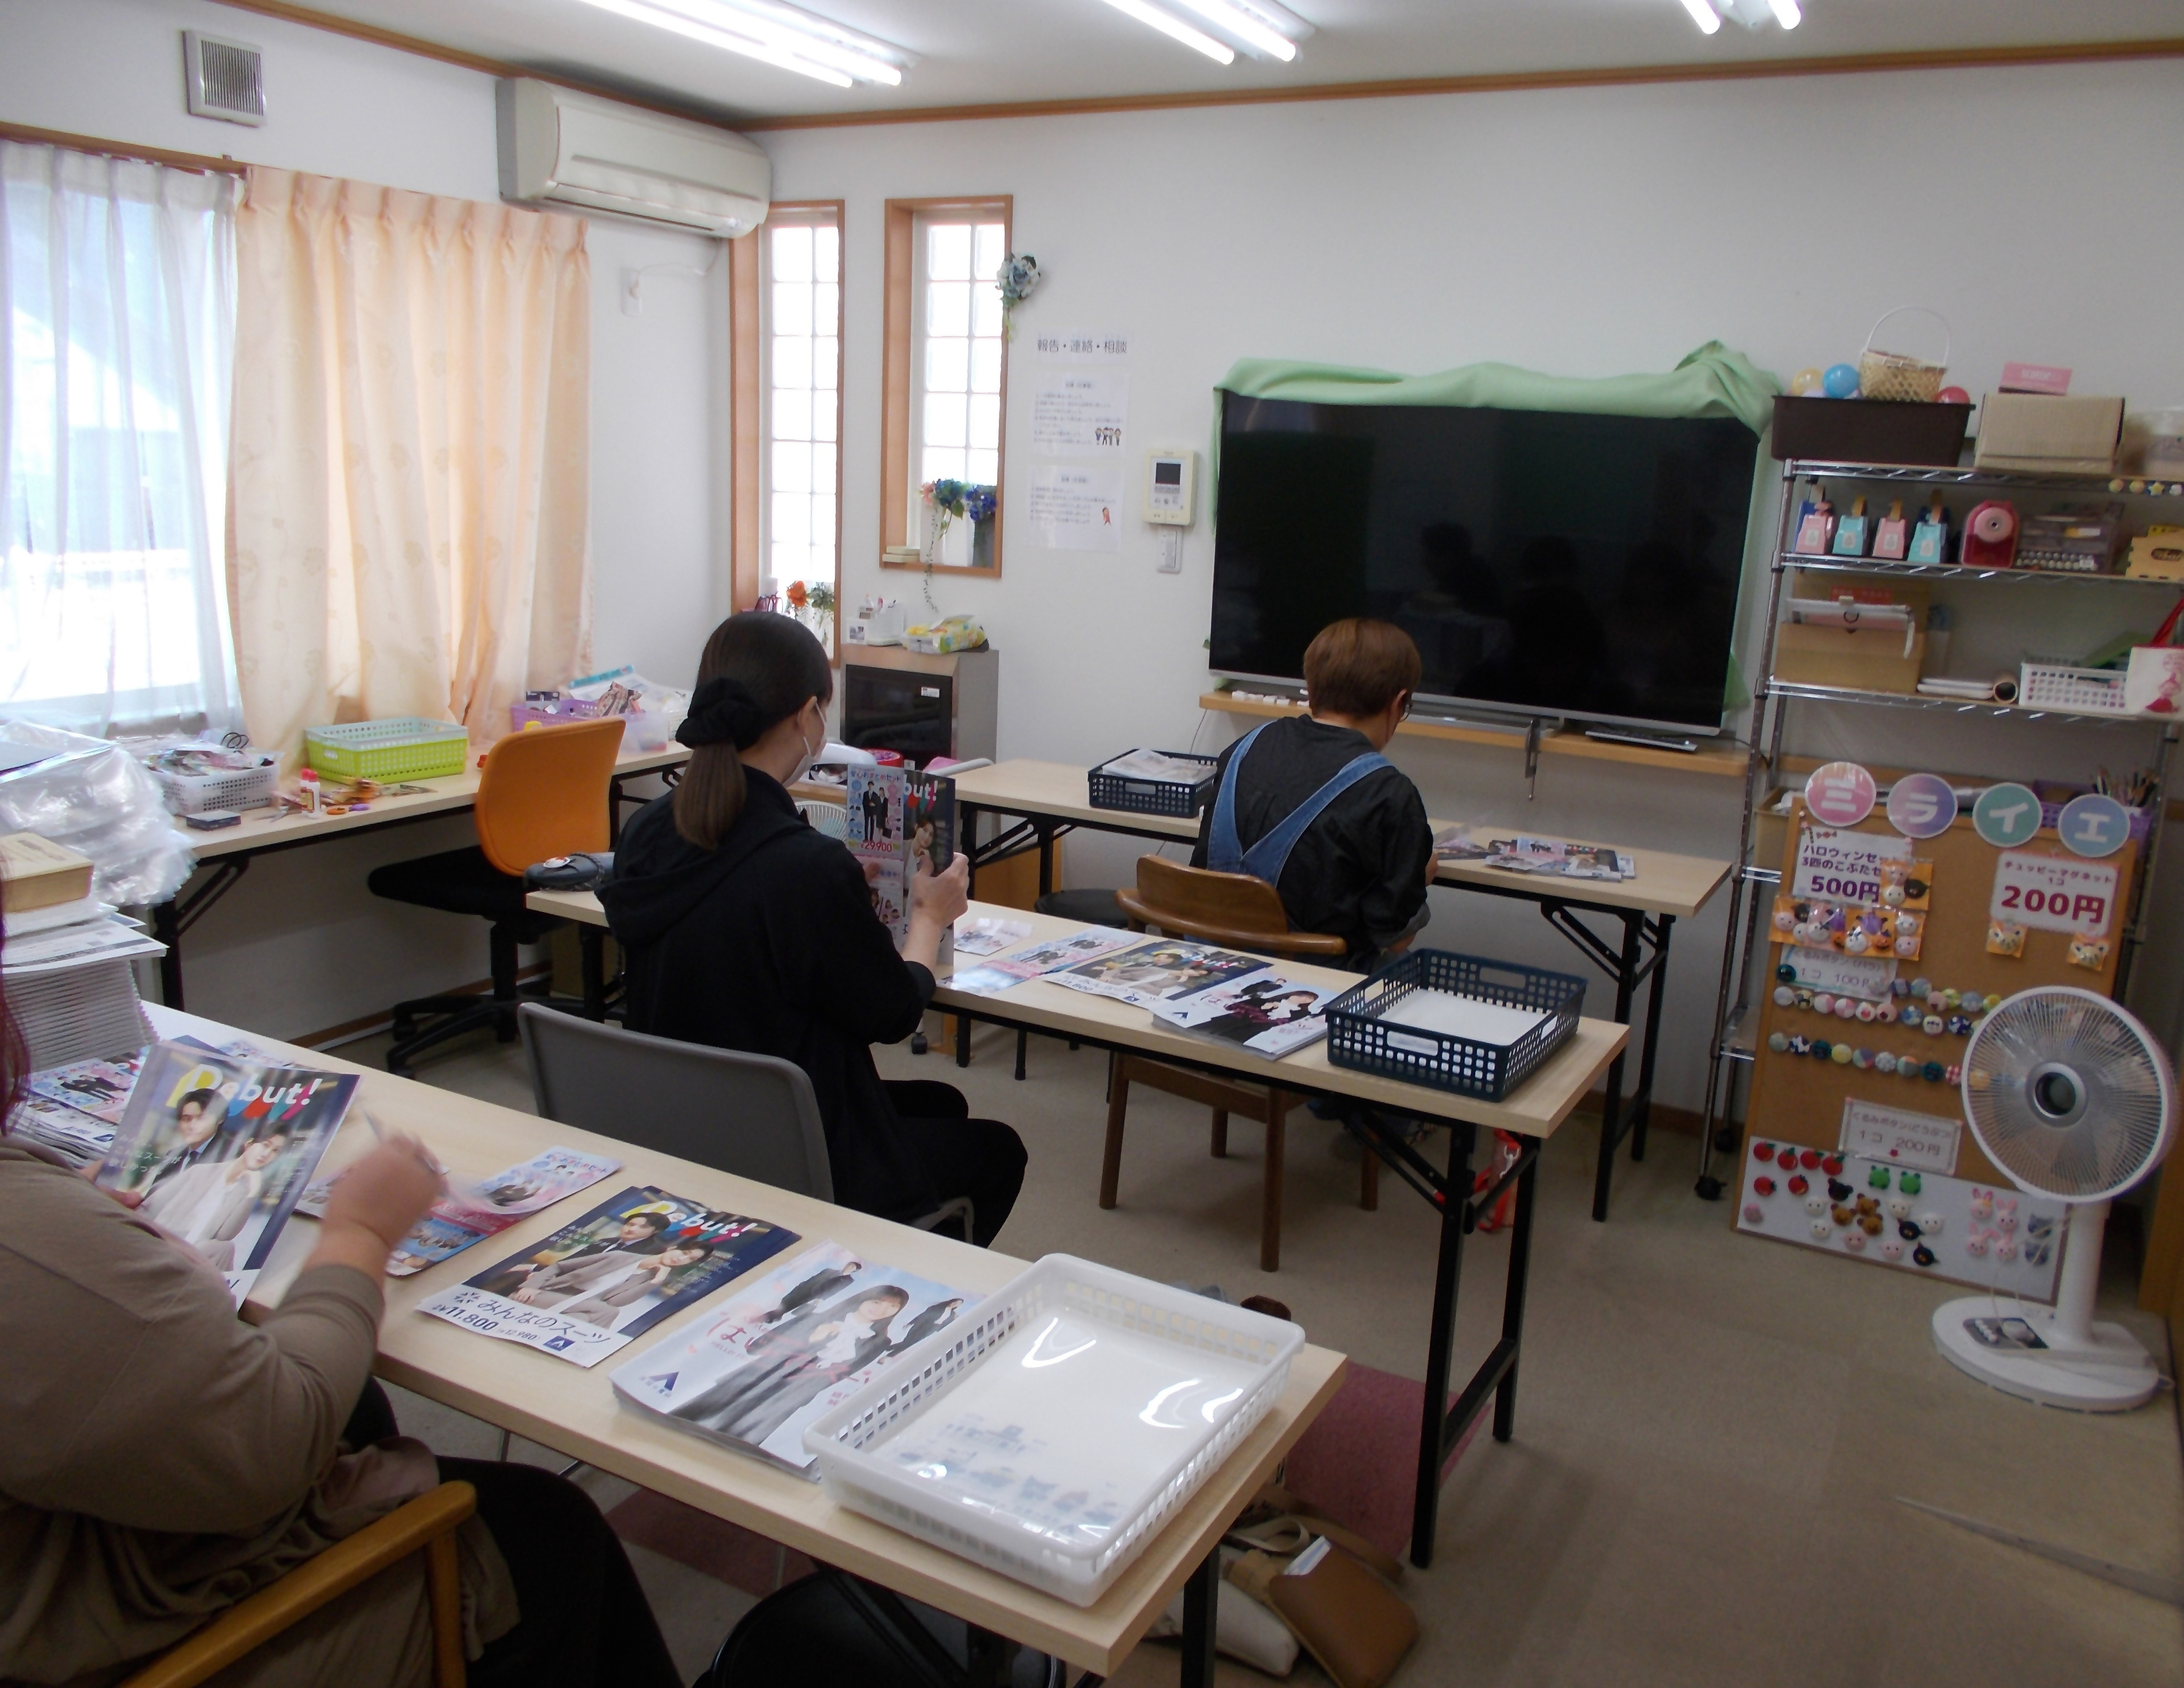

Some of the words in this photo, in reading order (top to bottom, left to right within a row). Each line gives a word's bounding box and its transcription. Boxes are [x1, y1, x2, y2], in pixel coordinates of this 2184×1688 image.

[1038, 338, 1127, 354] 報告・連絡・相談
[904, 774, 938, 802] but!
[1821, 778, 2110, 843] ミライエ
[1803, 845, 1881, 864] ハロウィンセ
[1811, 876, 1880, 903] 500円
[2001, 886, 2106, 924] 200円
[1896, 1136, 1940, 1156] 200円
[478, 1300, 611, 1344] みんなのスーツ
